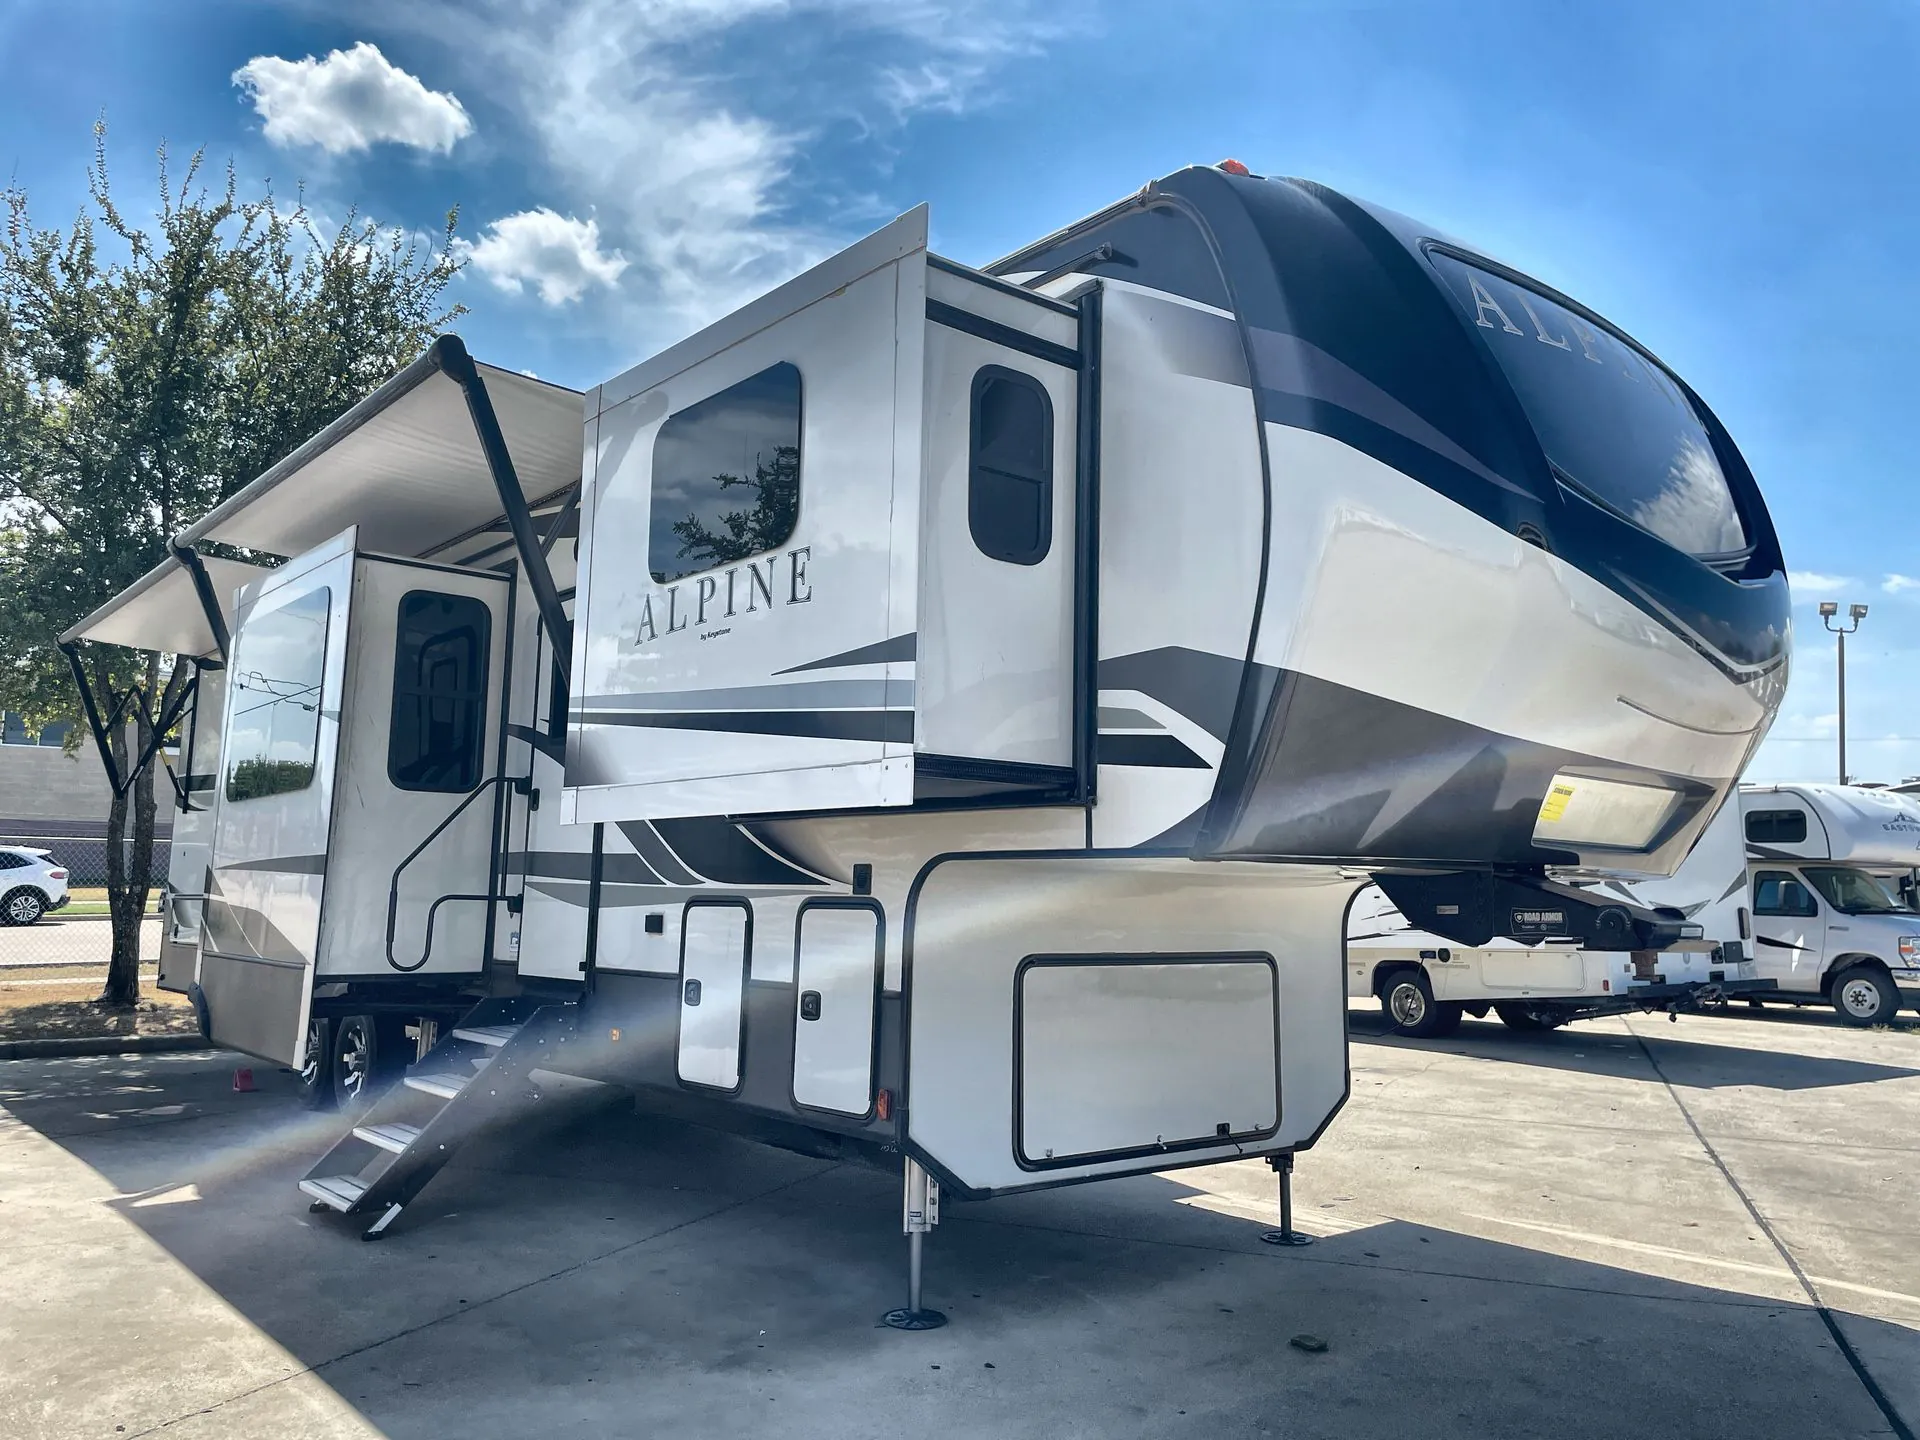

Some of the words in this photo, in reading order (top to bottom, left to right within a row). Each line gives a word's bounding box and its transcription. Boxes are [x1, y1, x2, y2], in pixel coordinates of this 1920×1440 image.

[634, 546, 812, 646] ALPINE
[700, 633, 707, 641] by
[1524, 912, 1541, 922] ROAD
[1541, 912, 1563, 922] ARMOR
